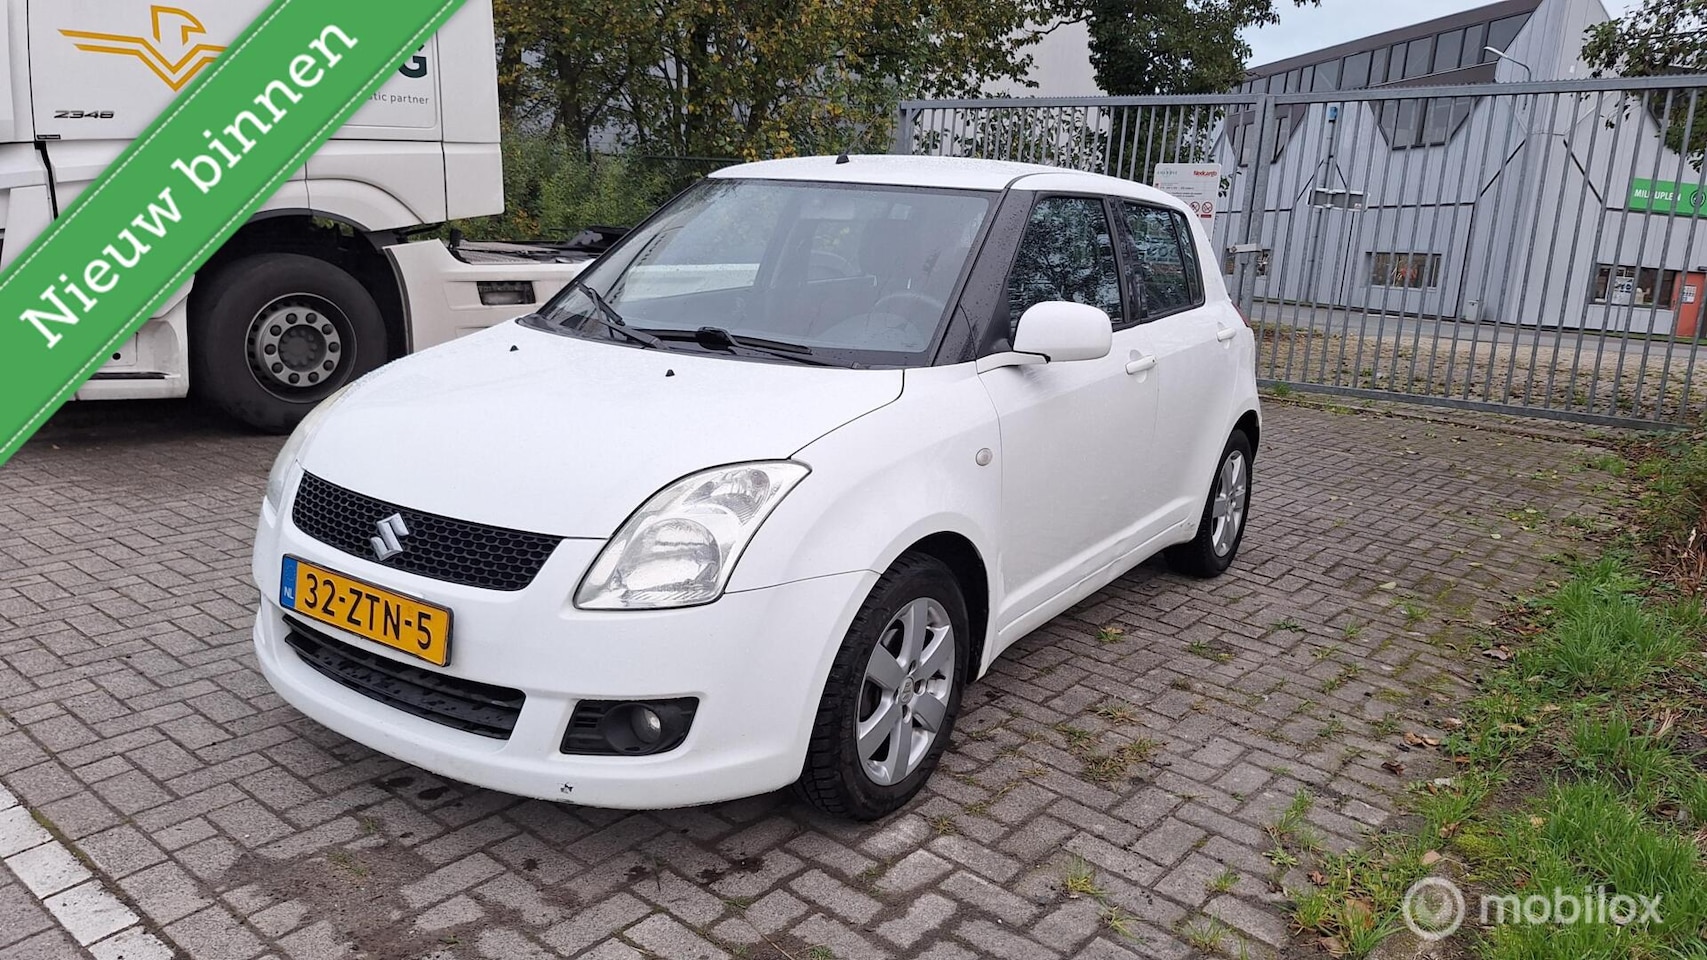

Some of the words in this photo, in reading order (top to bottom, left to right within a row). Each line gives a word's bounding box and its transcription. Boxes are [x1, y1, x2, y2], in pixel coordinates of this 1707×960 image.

[390, 94, 429, 104] partner
[283, 586, 294, 600] NL
[304, 573, 432, 650] 32-ZTN-5
